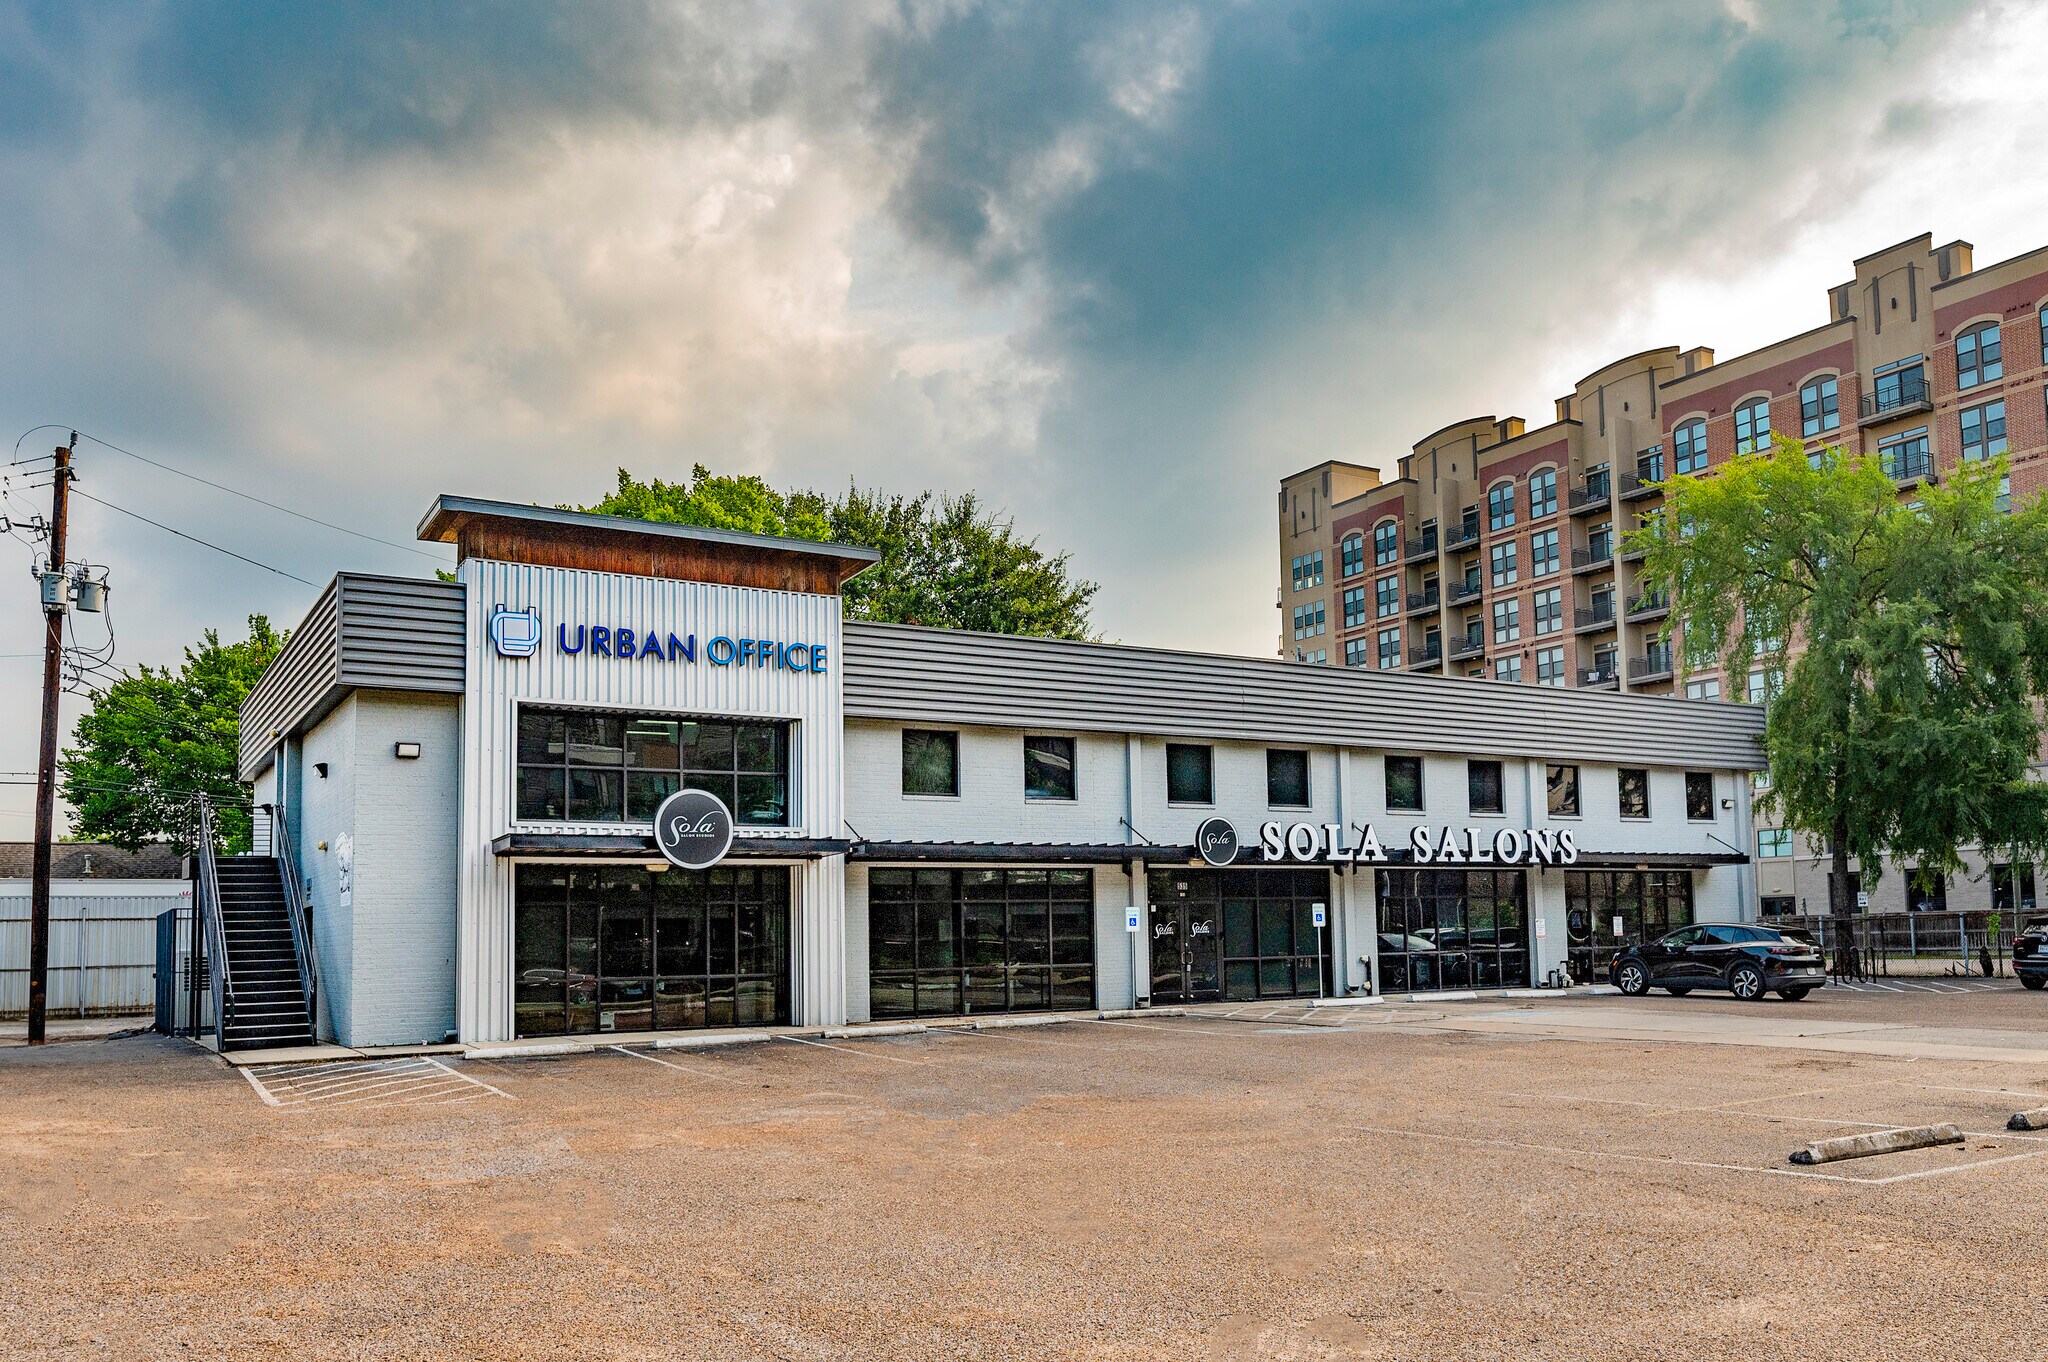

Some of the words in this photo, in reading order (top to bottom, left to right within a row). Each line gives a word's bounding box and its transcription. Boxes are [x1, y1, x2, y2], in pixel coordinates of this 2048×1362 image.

[560, 622, 695, 664] URBAN
[707, 636, 827, 673] OFFICE
[665, 810, 724, 847] Sola
[1203, 829, 1234, 853] Sola
[1260, 821, 1388, 862] SOLA
[1409, 825, 1578, 864] SALONS
